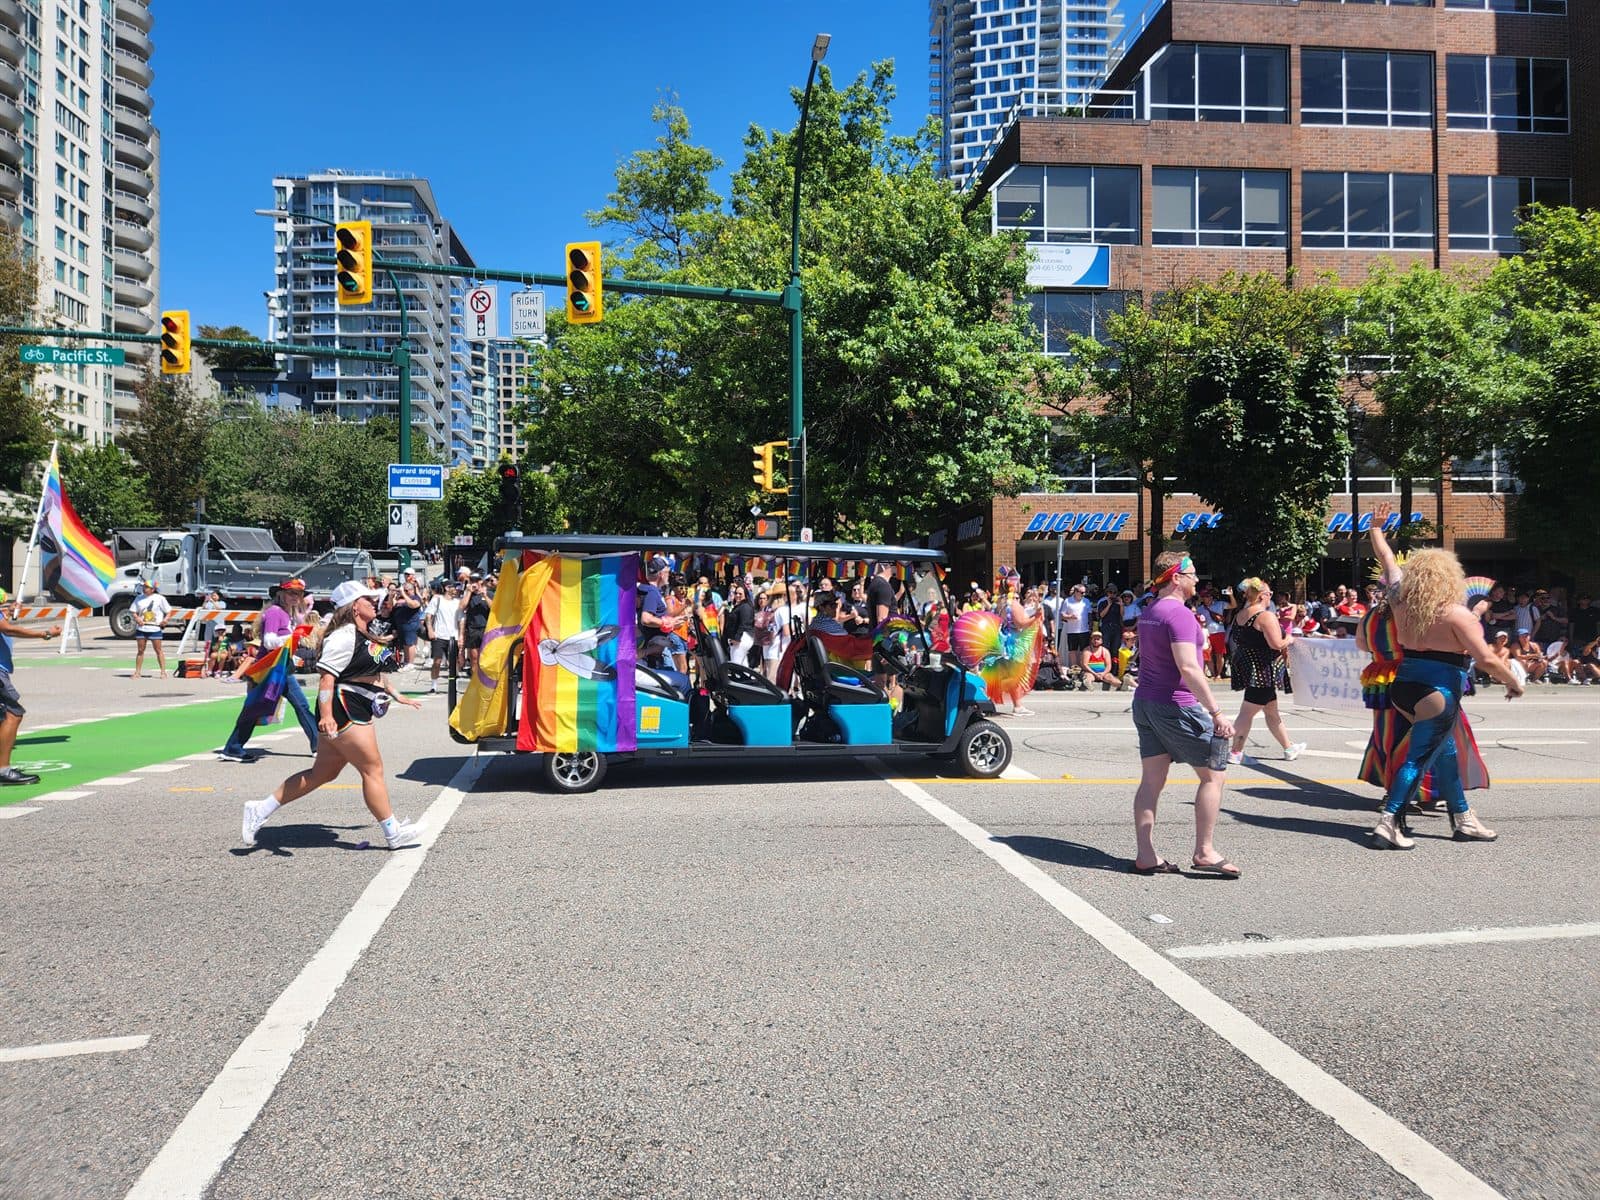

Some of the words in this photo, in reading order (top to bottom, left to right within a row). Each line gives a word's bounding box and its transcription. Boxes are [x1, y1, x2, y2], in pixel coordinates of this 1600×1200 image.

[516, 296, 539, 306] RIGHT
[519, 308, 538, 318] TURN
[514, 321, 541, 330] SIGNAL
[52, 349, 94, 362] Pacific
[95, 350, 113, 363] St.
[418, 468, 441, 476] Bridge
[1026, 512, 1131, 532] BICYCLE
